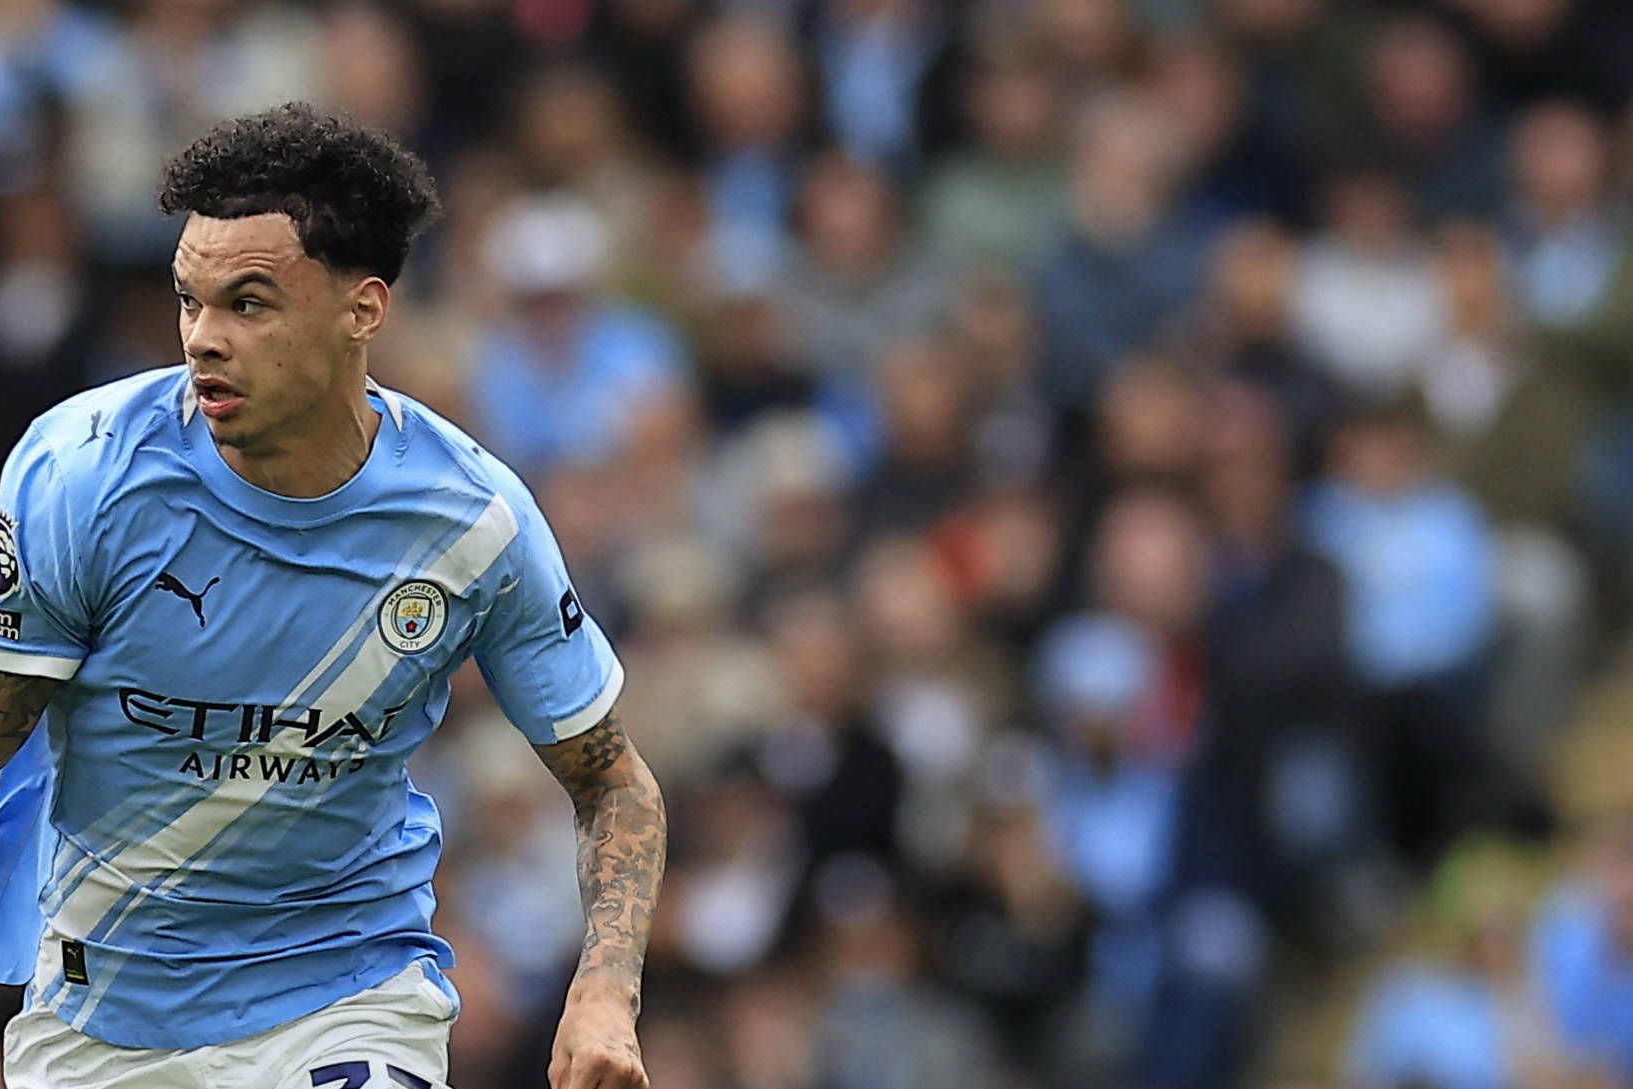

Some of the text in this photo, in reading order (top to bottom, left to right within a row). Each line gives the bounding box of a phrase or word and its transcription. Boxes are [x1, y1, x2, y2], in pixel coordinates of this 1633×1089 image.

[388, 585, 442, 607] MANCHESTER
[399, 641, 421, 649] CITY
[179, 752, 364, 785] AIRWAYS
